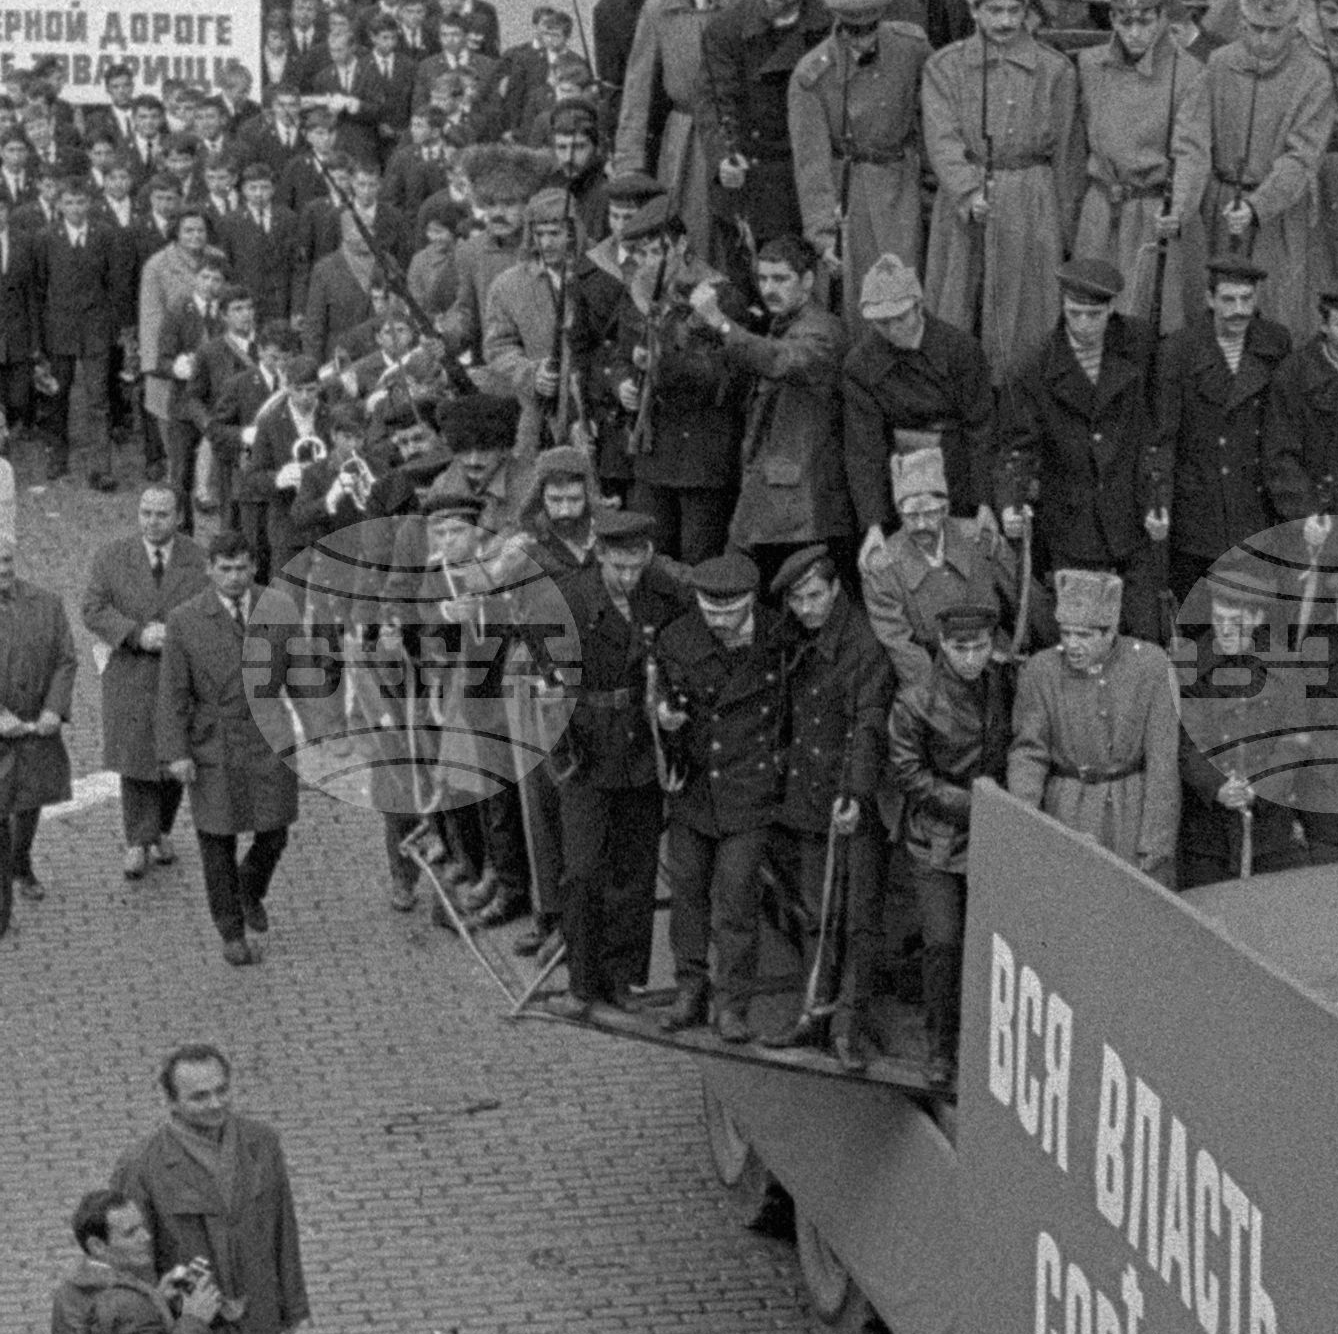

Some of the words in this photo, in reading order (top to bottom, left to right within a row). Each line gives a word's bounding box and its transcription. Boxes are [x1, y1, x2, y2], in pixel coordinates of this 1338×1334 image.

[0, 0, 88, 43] РНОЙ
[98, 11, 233, 51] ДОРОГЕ
[988, 931, 1073, 1173] ВСЯ
